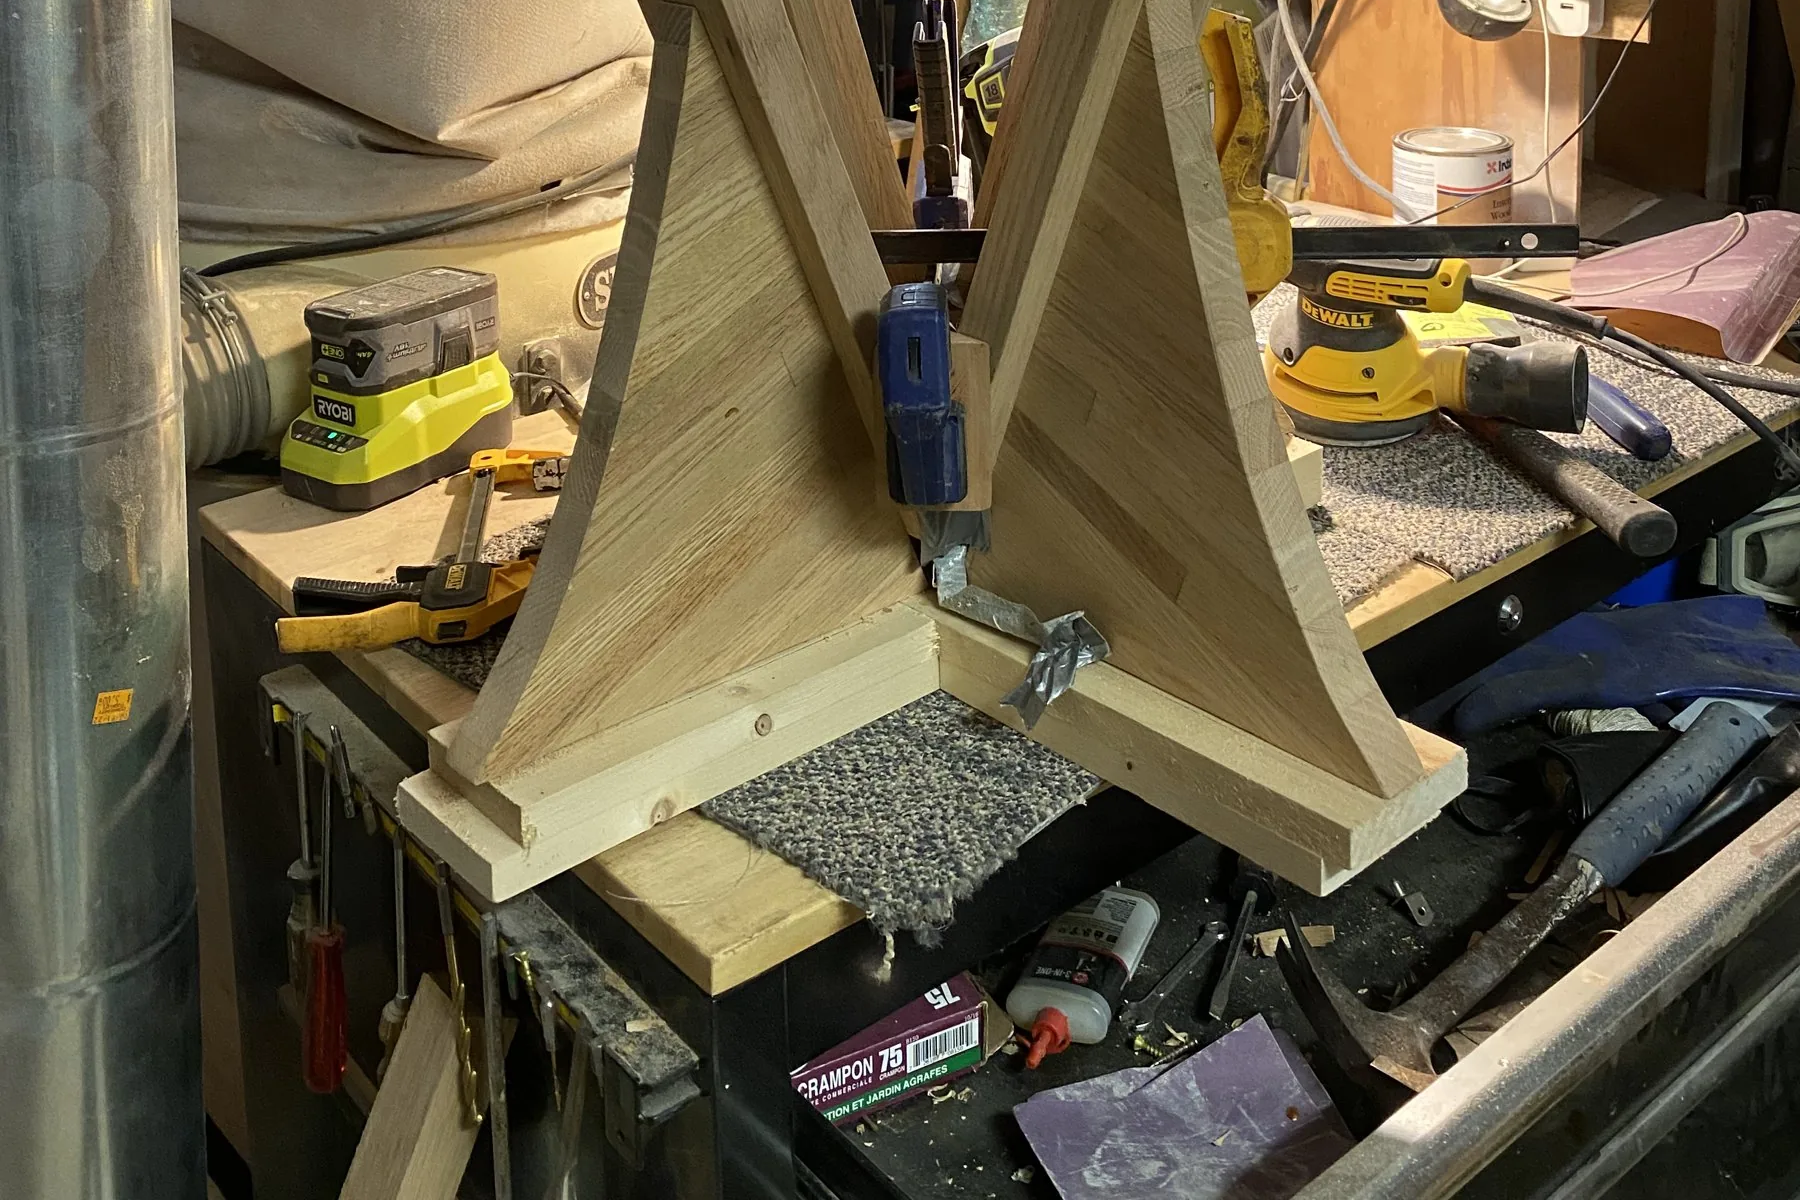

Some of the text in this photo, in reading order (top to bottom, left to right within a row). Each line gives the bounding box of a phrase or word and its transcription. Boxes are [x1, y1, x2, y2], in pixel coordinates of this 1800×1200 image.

[985, 83, 998, 97] 18
[594, 265, 616, 312] S
[475, 316, 495, 331] RYOBI
[317, 398, 353, 422] RYOBI
[1036, 967, 1072, 979] 3-IN-ONE
[924, 982, 960, 1010] 75
[798, 1043, 903, 1099] CRAMPON 75
[879, 1066, 906, 1081] CRAMPON
[822, 1076, 873, 1102] COMMERCIALE
[823, 1064, 948, 1122] TION ET JARDIN AGRAFES
